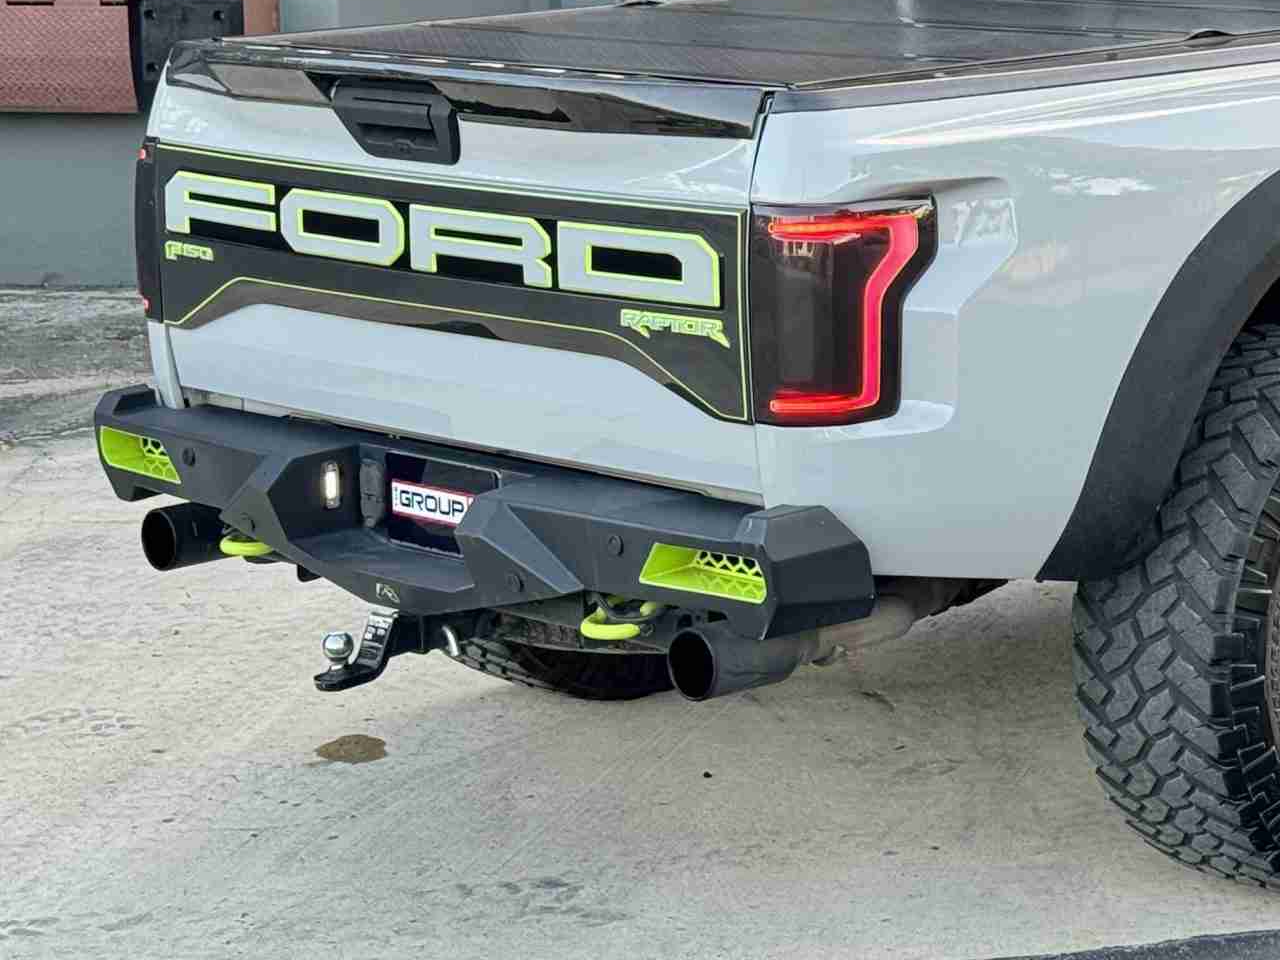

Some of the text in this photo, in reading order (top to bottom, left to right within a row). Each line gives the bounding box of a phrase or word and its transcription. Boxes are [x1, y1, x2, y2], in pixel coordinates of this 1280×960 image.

[164, 169, 721, 308] FORD
[620, 307, 731, 349] RAPTOR
[399, 489, 465, 518] GROUP
